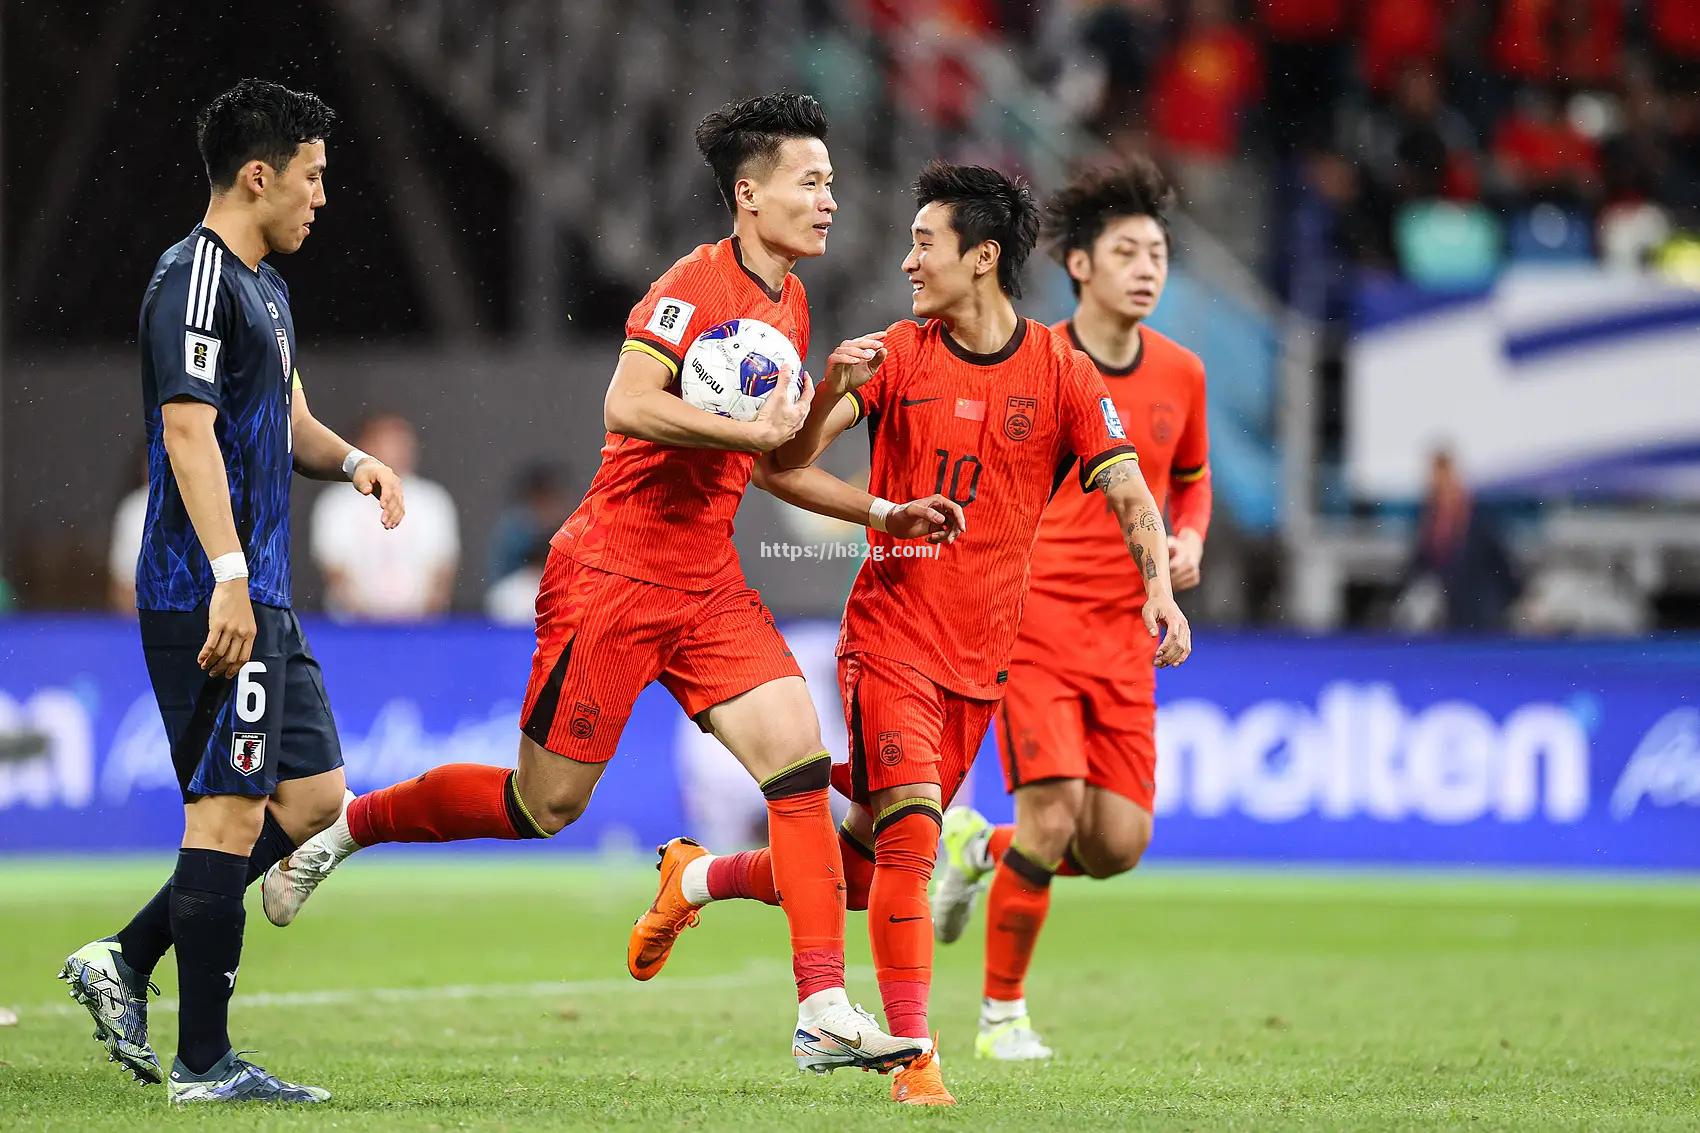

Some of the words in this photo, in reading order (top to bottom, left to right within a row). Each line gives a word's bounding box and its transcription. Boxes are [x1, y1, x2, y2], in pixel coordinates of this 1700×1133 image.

[692, 358, 724, 394] molten
[1010, 399, 1035, 409] CFA
[935, 448, 983, 508] 10
[236, 661, 267, 723] 6
